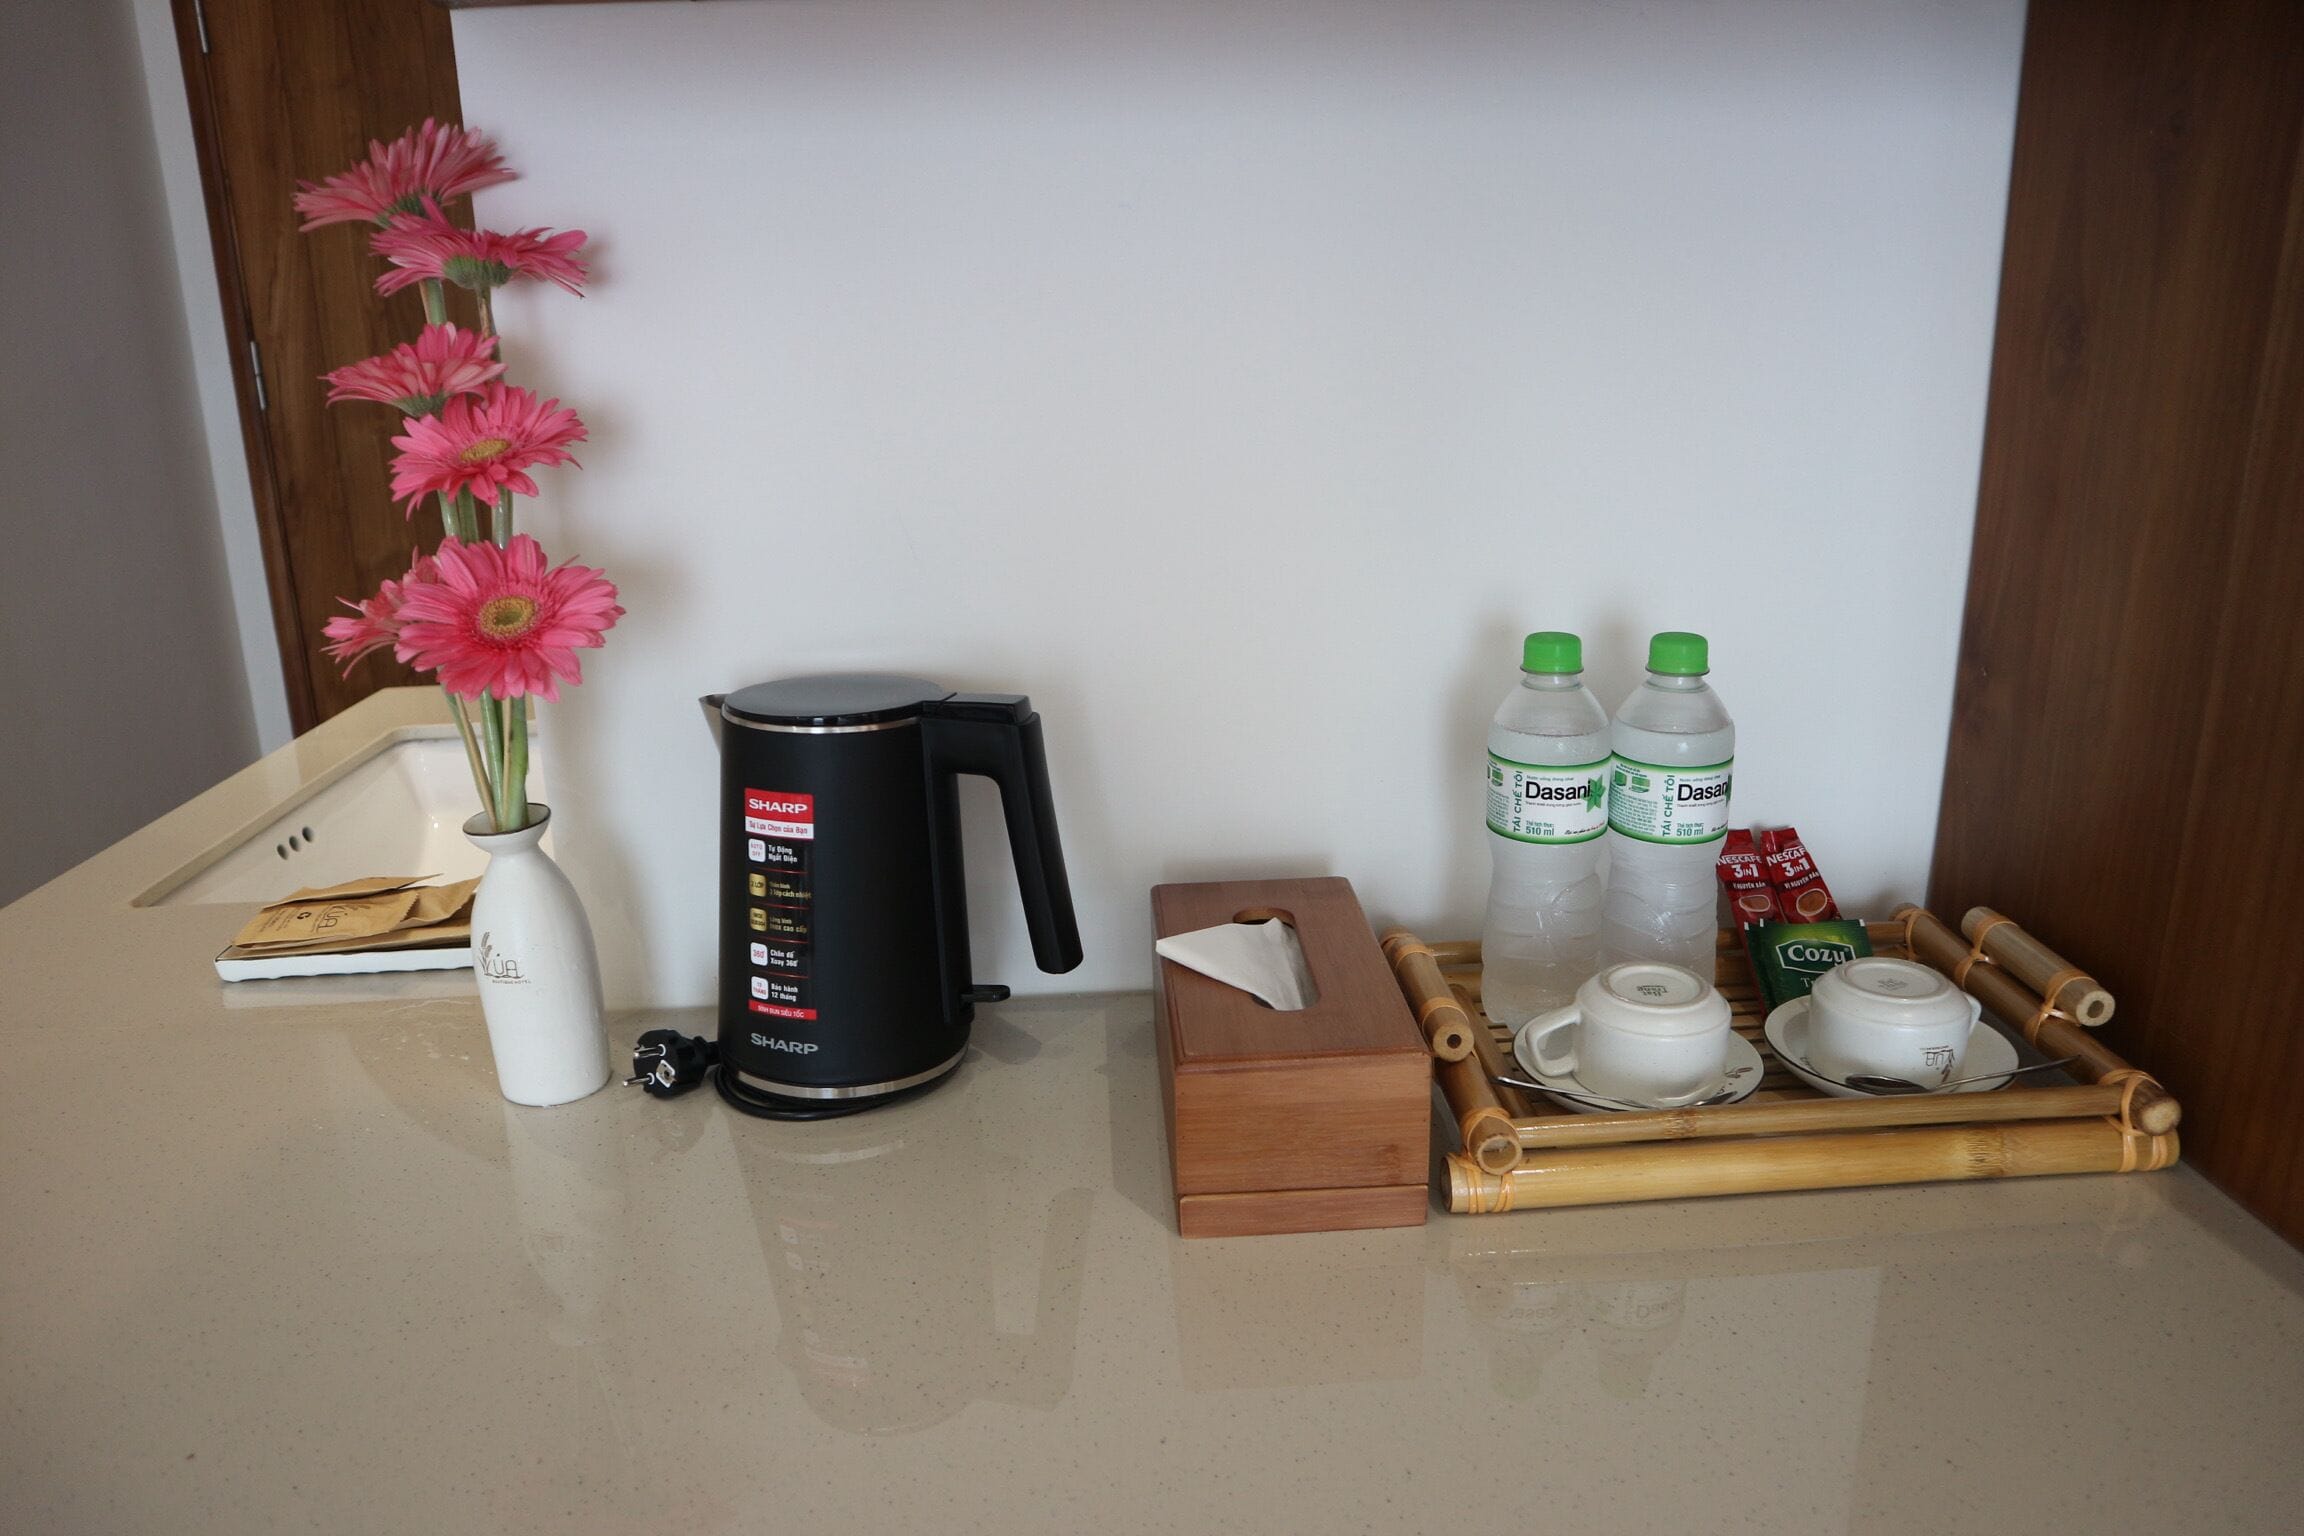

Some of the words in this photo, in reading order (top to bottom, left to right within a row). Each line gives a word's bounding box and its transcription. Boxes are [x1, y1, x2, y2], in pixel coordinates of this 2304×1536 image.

[1525, 779, 1591, 801] Dasani
[748, 798, 808, 814] SHARP
[1525, 826, 1541, 836] 510
[1543, 827, 1554, 836] ml
[1676, 828, 1692, 836] 510
[1787, 944, 1847, 967] Cozy
[771, 991, 779, 999] 12
[750, 1032, 819, 1055] SHARP
